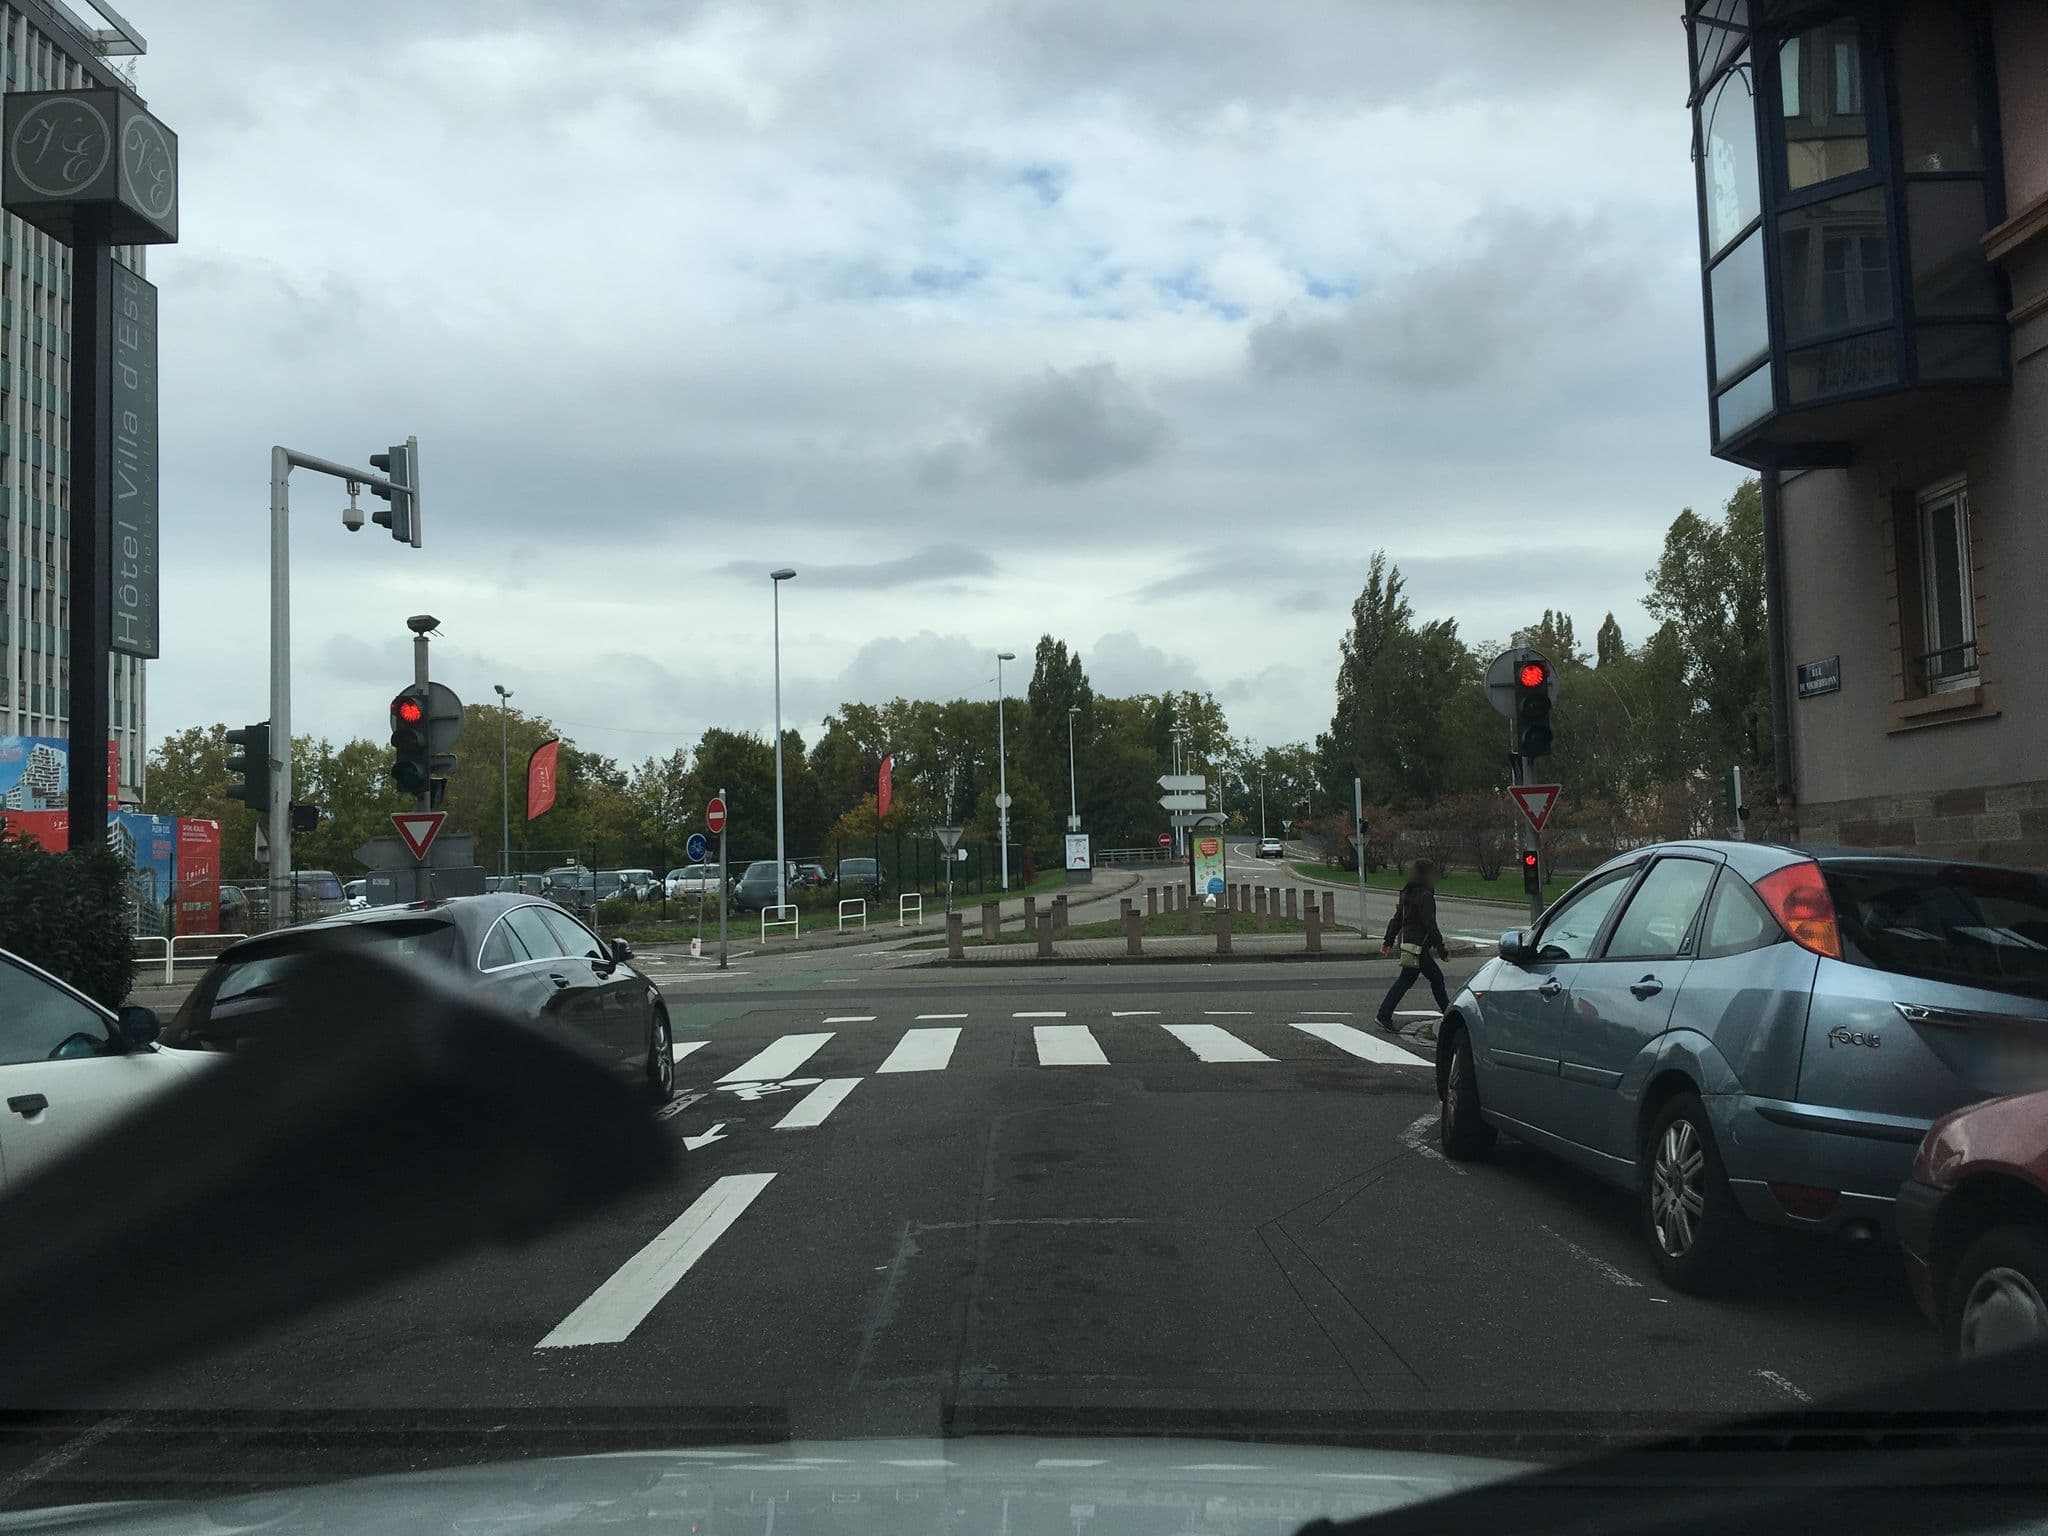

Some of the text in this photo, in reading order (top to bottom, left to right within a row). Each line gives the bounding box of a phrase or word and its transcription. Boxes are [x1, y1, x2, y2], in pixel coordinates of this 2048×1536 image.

[118, 279, 138, 645] Hôtel Villa d'Est
